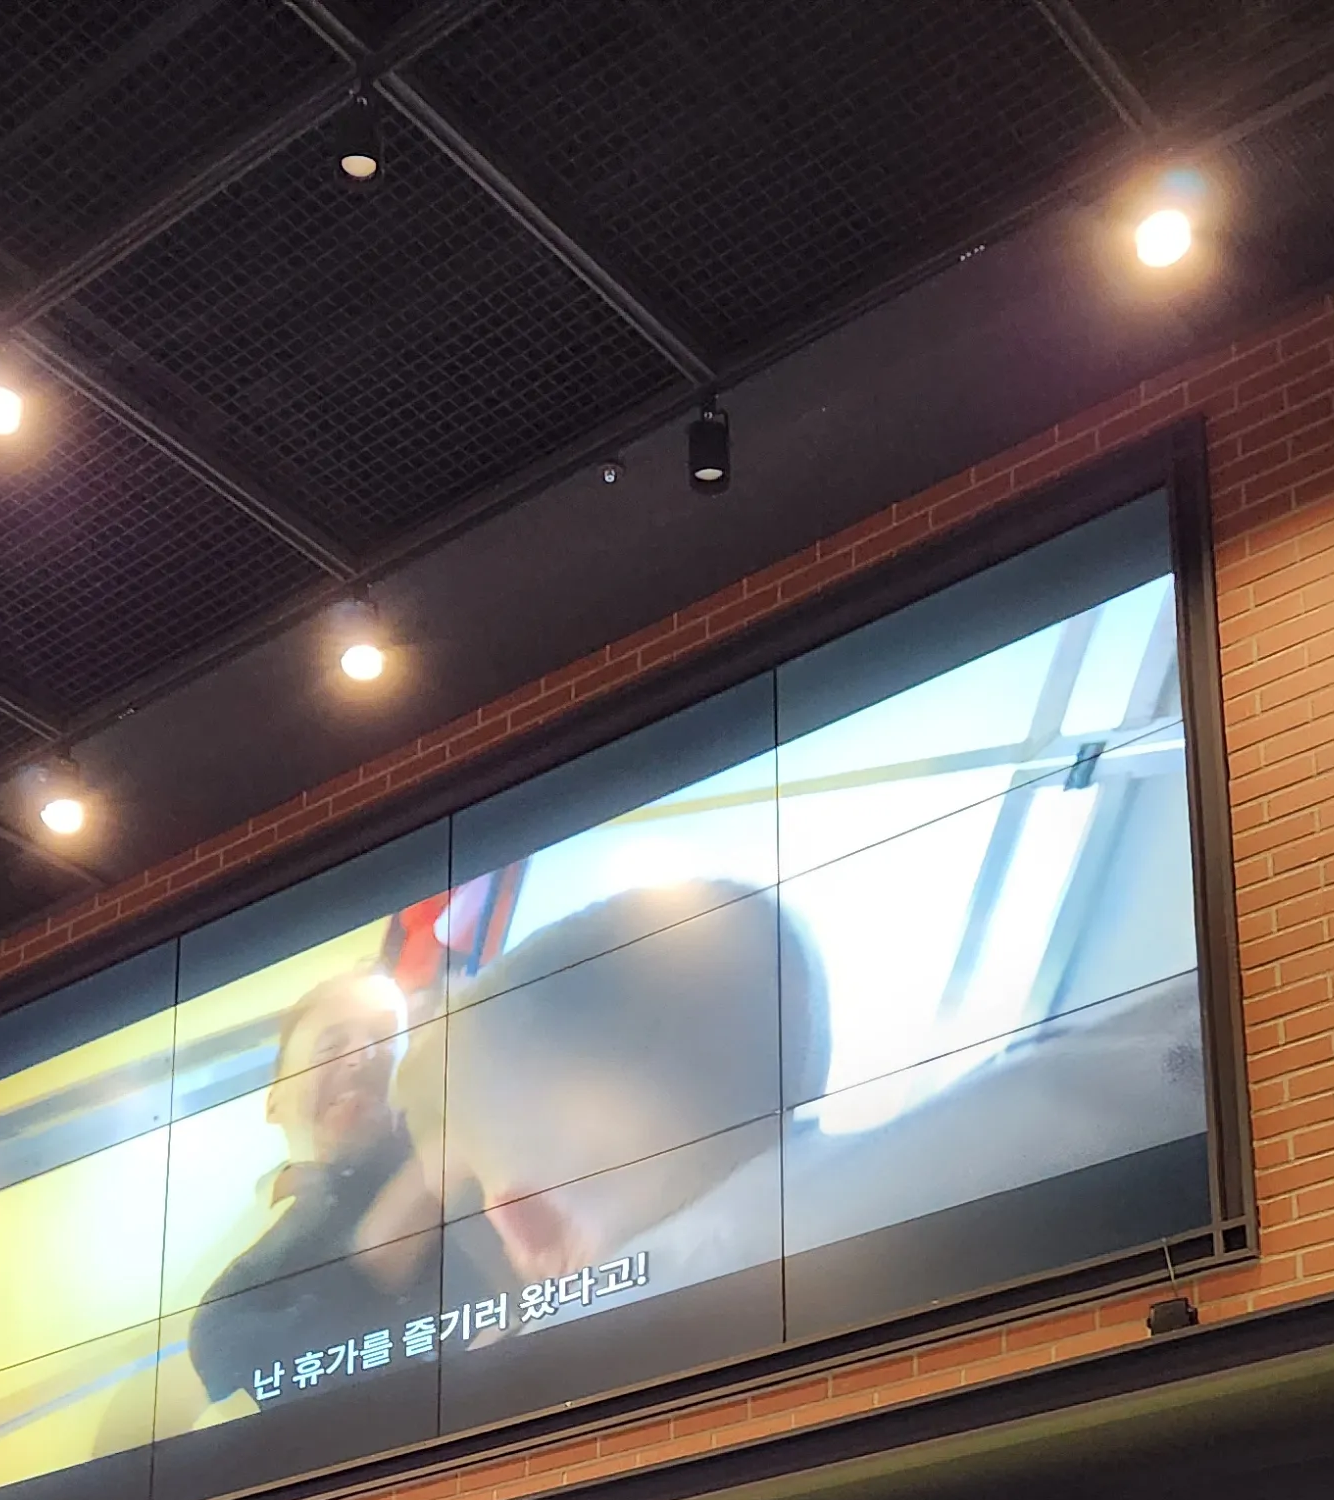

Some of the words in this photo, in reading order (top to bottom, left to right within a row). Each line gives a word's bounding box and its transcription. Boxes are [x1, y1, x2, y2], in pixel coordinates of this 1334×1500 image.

[253, 1366, 283, 1400] 난
[292, 1329, 393, 1388] 휴가를
[402, 1294, 507, 1358] 즐기러
[519, 1251, 650, 1323] 왔다고!
